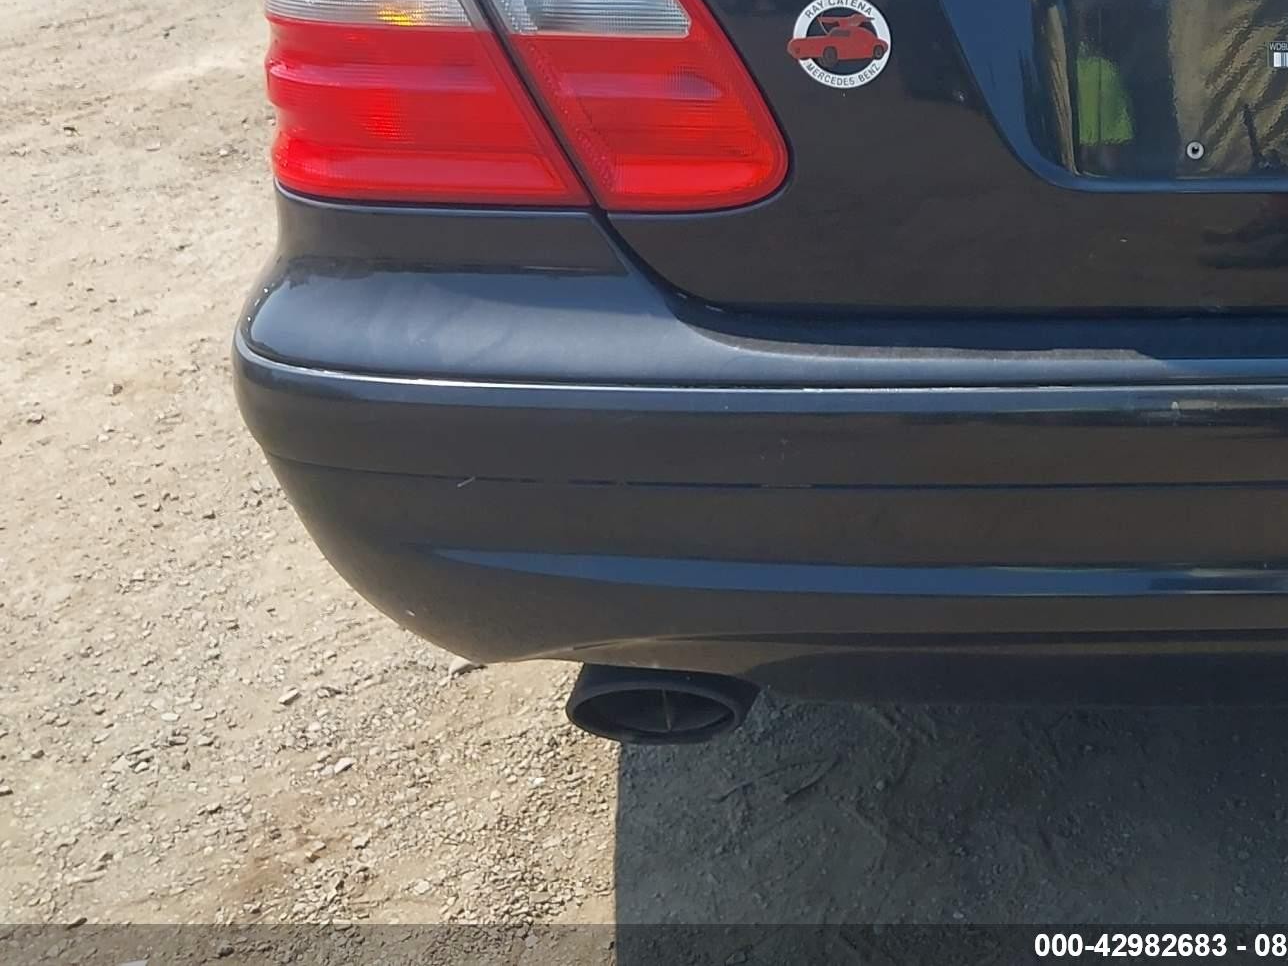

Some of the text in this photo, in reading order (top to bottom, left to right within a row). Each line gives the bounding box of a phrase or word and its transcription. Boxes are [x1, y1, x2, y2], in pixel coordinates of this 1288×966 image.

[805, 0, 825, 18] RAY
[806, 63, 880, 86] MERCEDES BENZ
